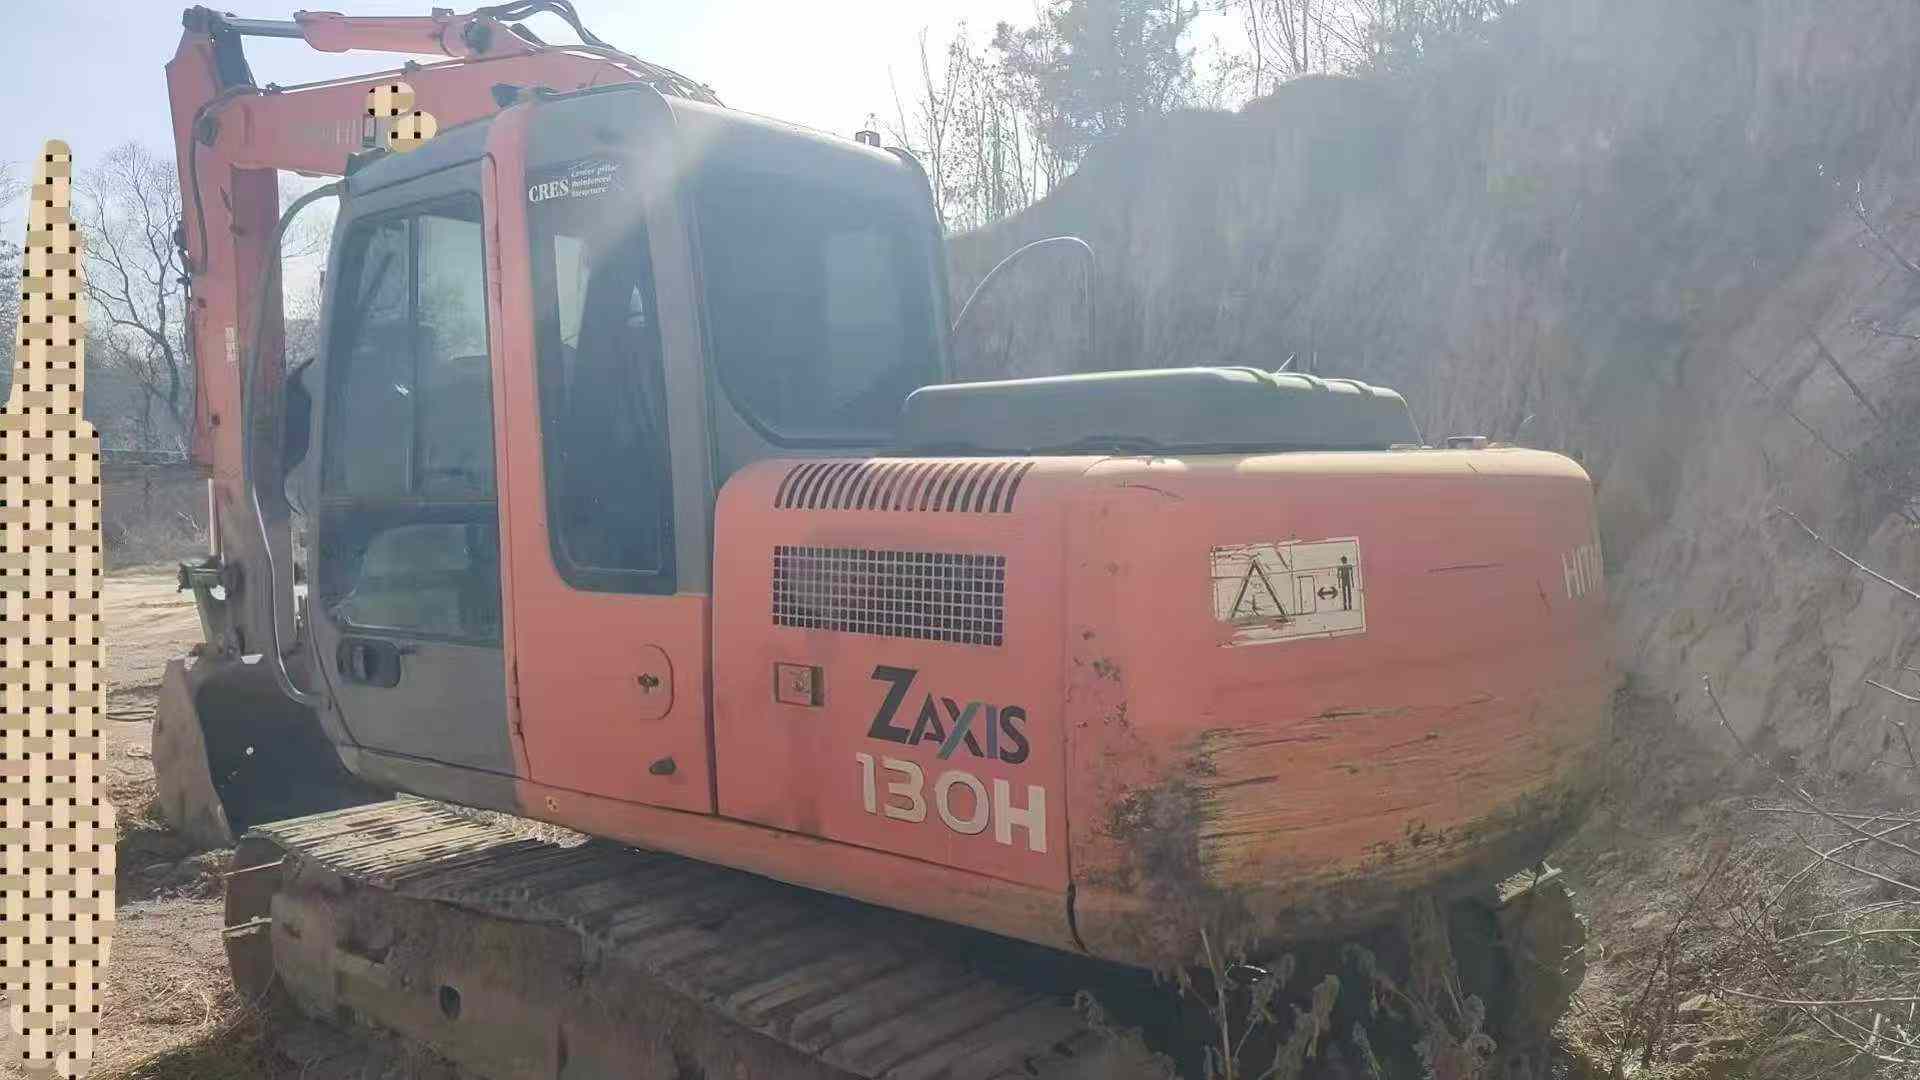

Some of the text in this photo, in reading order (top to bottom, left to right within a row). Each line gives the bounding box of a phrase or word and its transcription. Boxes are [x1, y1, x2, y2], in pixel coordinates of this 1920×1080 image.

[528, 179, 569, 202] CRES
[867, 664, 1031, 765] ZAXIS
[856, 752, 1047, 854] 130H
